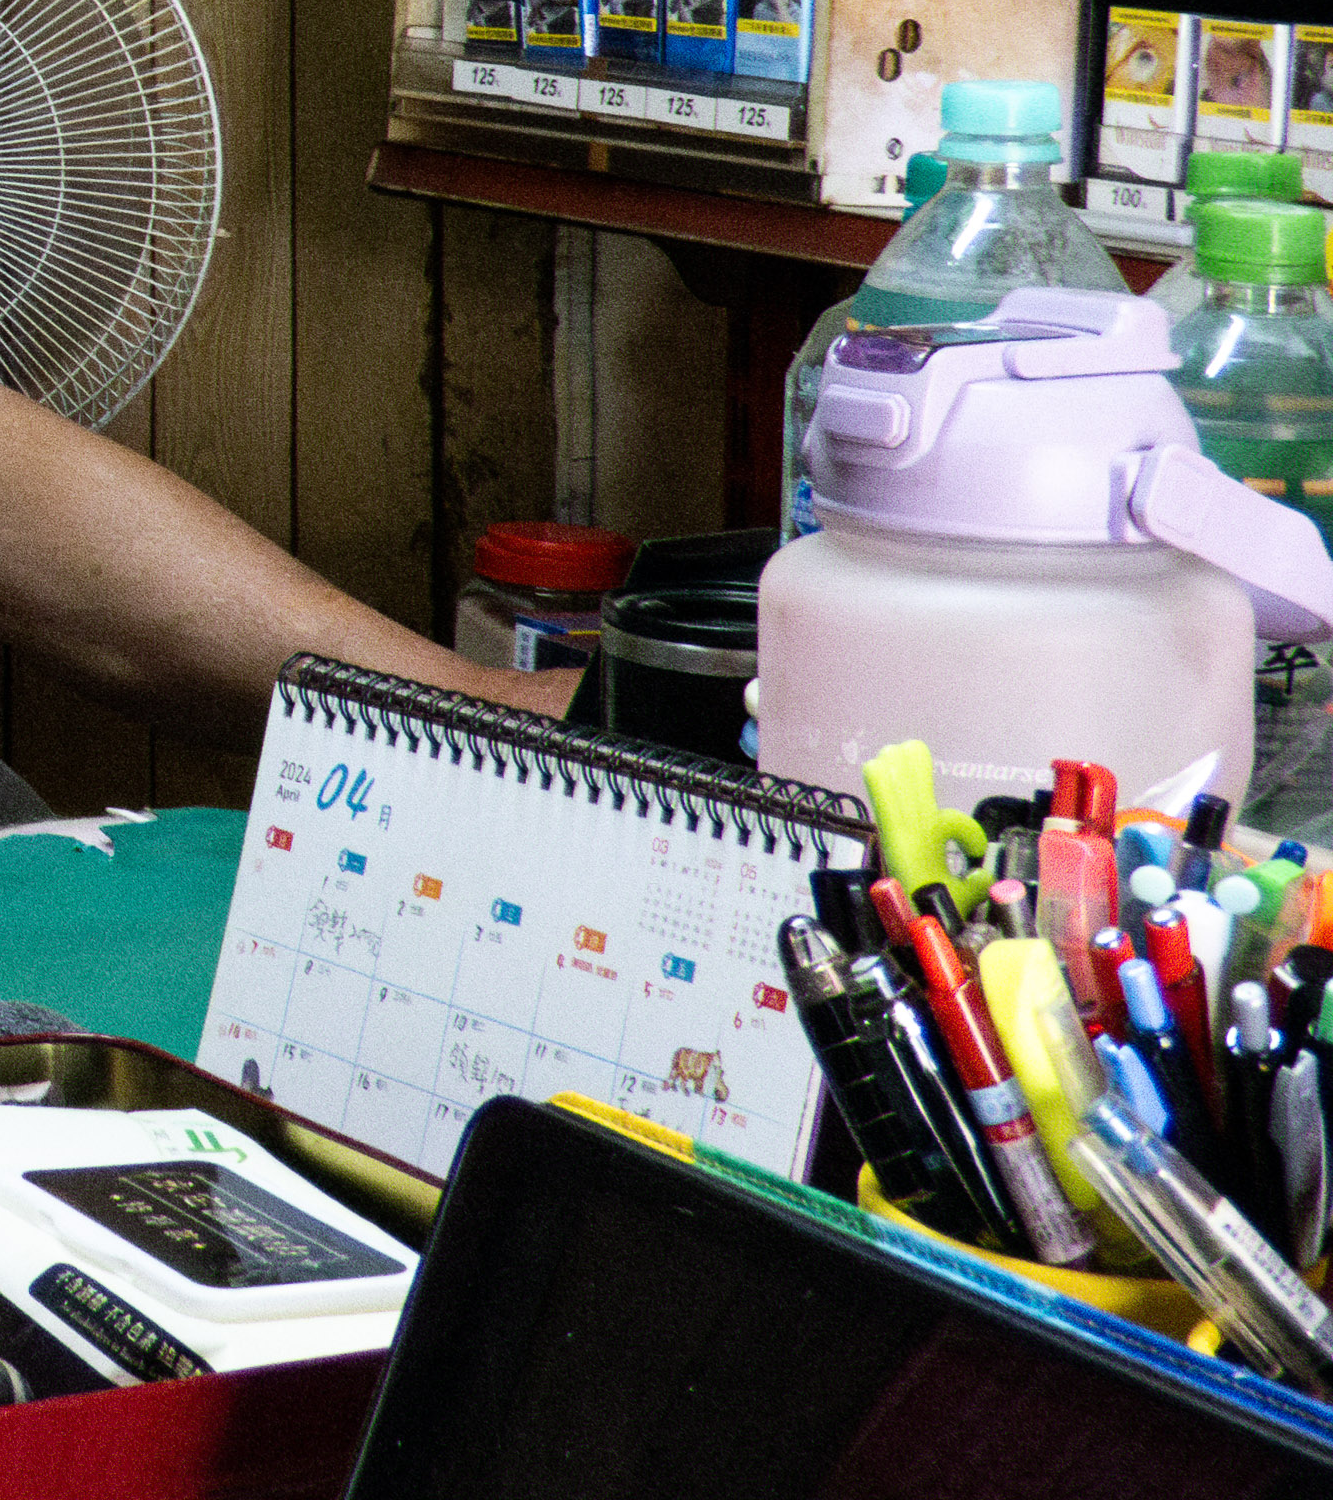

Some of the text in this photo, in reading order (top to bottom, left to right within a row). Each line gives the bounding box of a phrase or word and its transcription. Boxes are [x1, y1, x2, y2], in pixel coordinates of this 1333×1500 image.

[275, 784, 301, 802] April
[279, 759, 375, 820] 2024 04
[379, 804, 392, 832] 月
[397, 900, 406, 916] 2
[475, 925, 484, 941] 3
[733, 1011, 742, 1029] 6
[357, 1071, 371, 1088] 16
[621, 1073, 637, 1093] 12
[711, 1106, 727, 1126] 13
